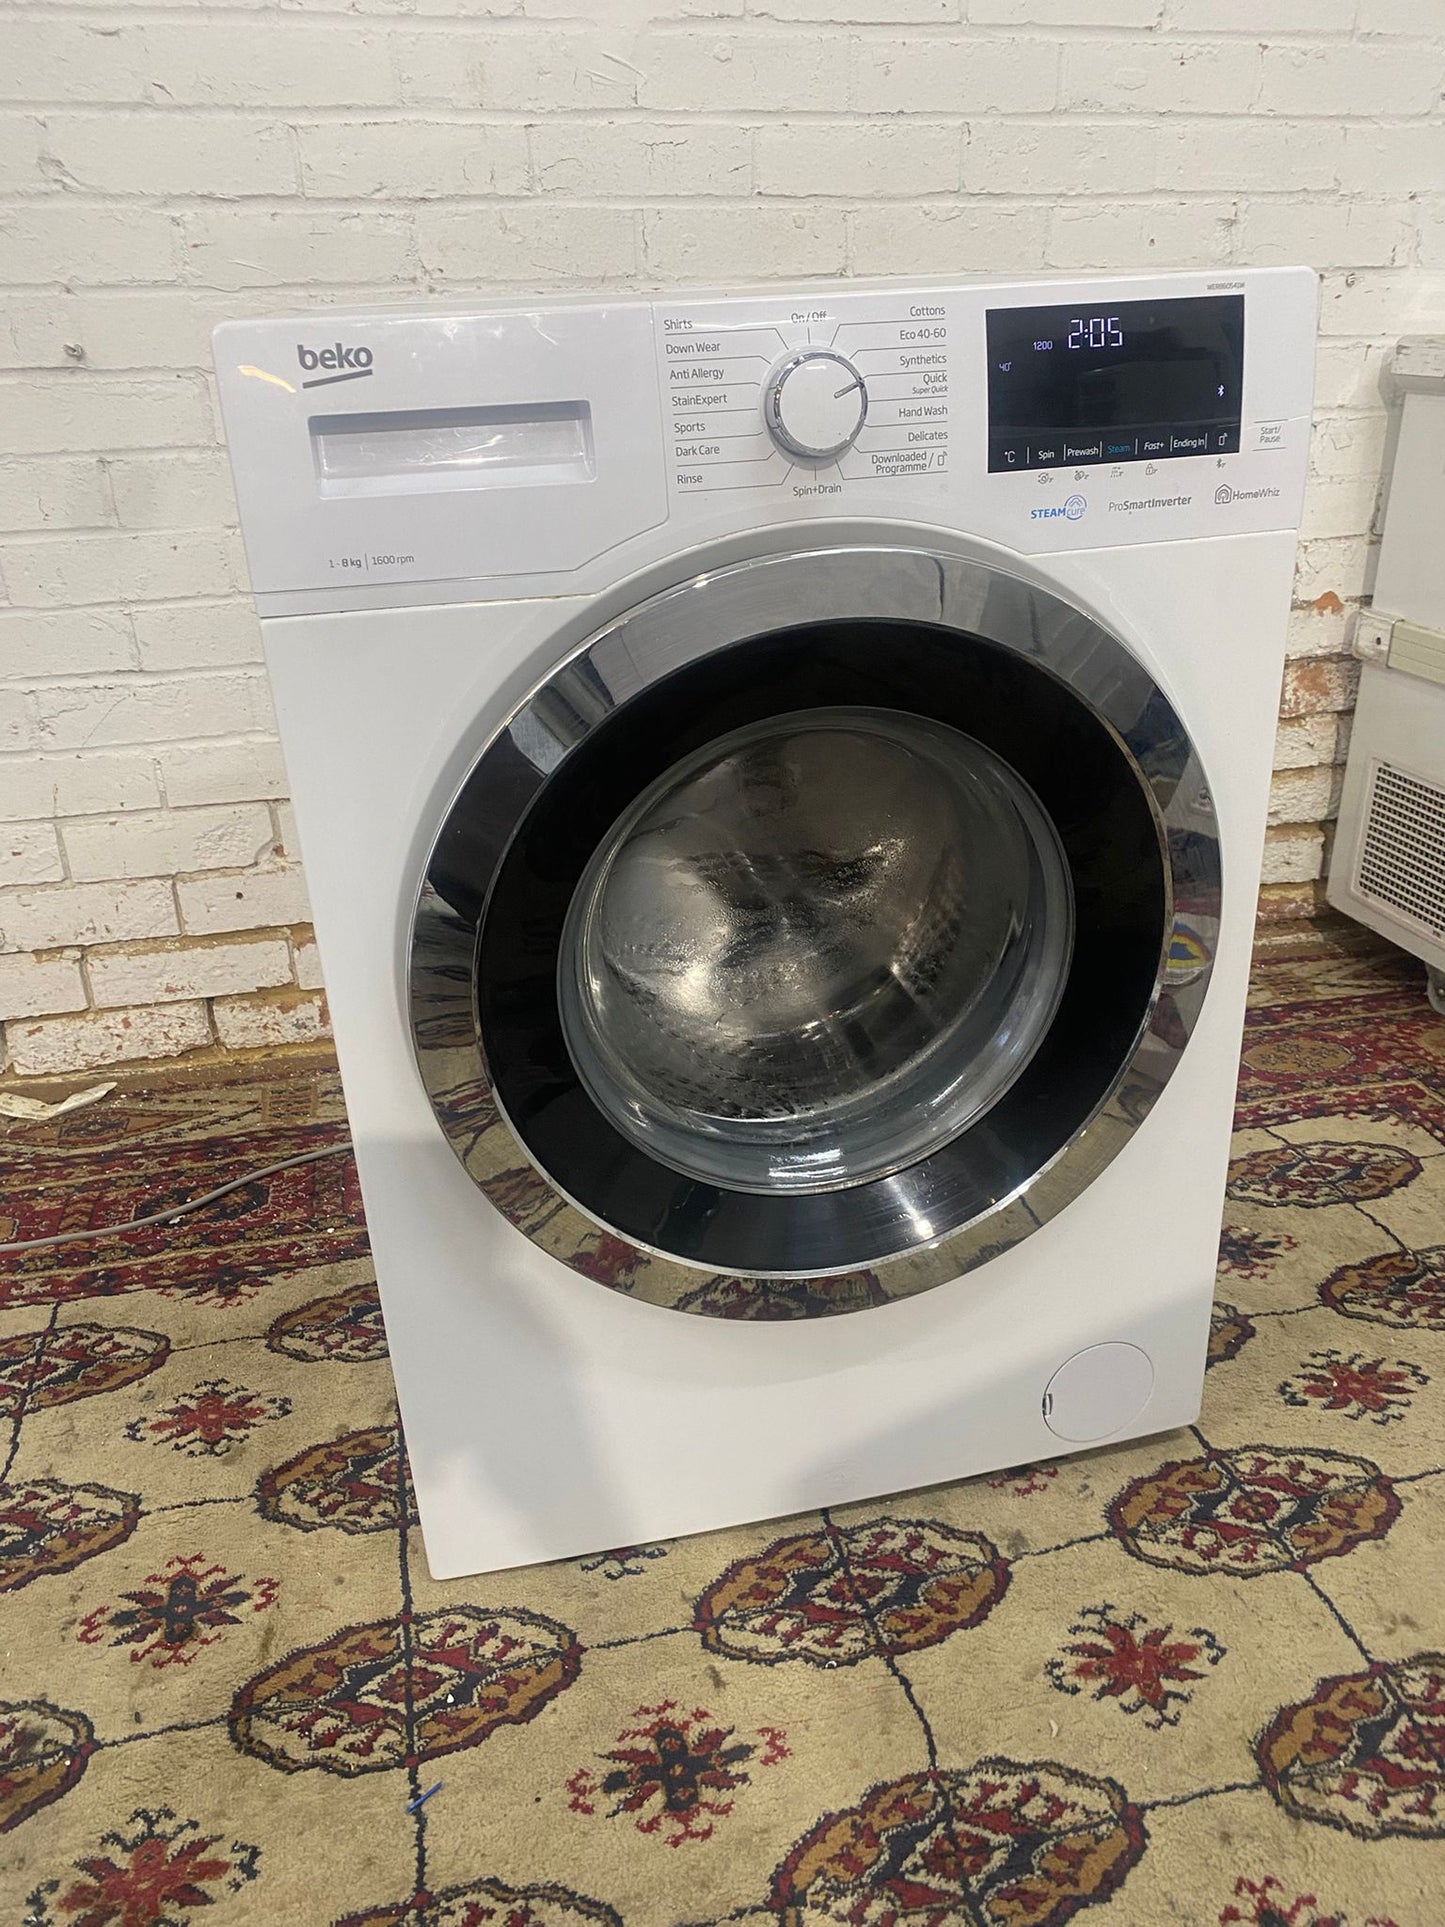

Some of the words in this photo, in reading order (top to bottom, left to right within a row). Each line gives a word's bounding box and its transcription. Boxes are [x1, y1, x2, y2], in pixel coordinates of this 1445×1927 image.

[910, 306, 946, 317] Cottons
[664, 319, 693, 331] Shirts
[900, 330, 916, 340] Eco
[918, 328, 947, 339] 40-60
[1068, 317, 1123, 349] 2:05
[666, 342, 694, 354] Down
[695, 341, 720, 352] Wear
[1032, 340, 1053, 351] 1200
[297, 343, 373, 371] beko
[900, 354, 947, 368] Synthetics
[670, 369, 690, 380] Anti
[692, 367, 724, 382] Allergy
[923, 373, 948, 385] Quick
[912, 386, 931, 395] Super
[932, 385, 949, 394] Quick
[672, 393, 727, 407] StainExpert
[899, 406, 922, 418] Hand
[923, 405, 948, 416] Wash
[674, 421, 706, 434] Sports
[907, 430, 948, 442] Delicates
[1260, 435, 1281, 444] Pause
[1107, 444, 1131, 453] Steam
[1173, 439, 1198, 450] Ending
[675, 446, 697, 458] Dark
[698, 445, 720, 456] Care
[871, 451, 927, 464] Downloaded
[1038, 450, 1055, 460] Spin
[1067, 446, 1099, 457] Prewash
[876, 463, 927, 476] Programme
[677, 473, 703, 485] Rinse
[793, 483, 842, 497] Spin+Drain
[1232, 487, 1280, 501] HomeWhiz
[1109, 496, 1192, 512] ProSmartInverter
[372, 555, 395, 566] 1600
[397, 555, 415, 565] rpm
